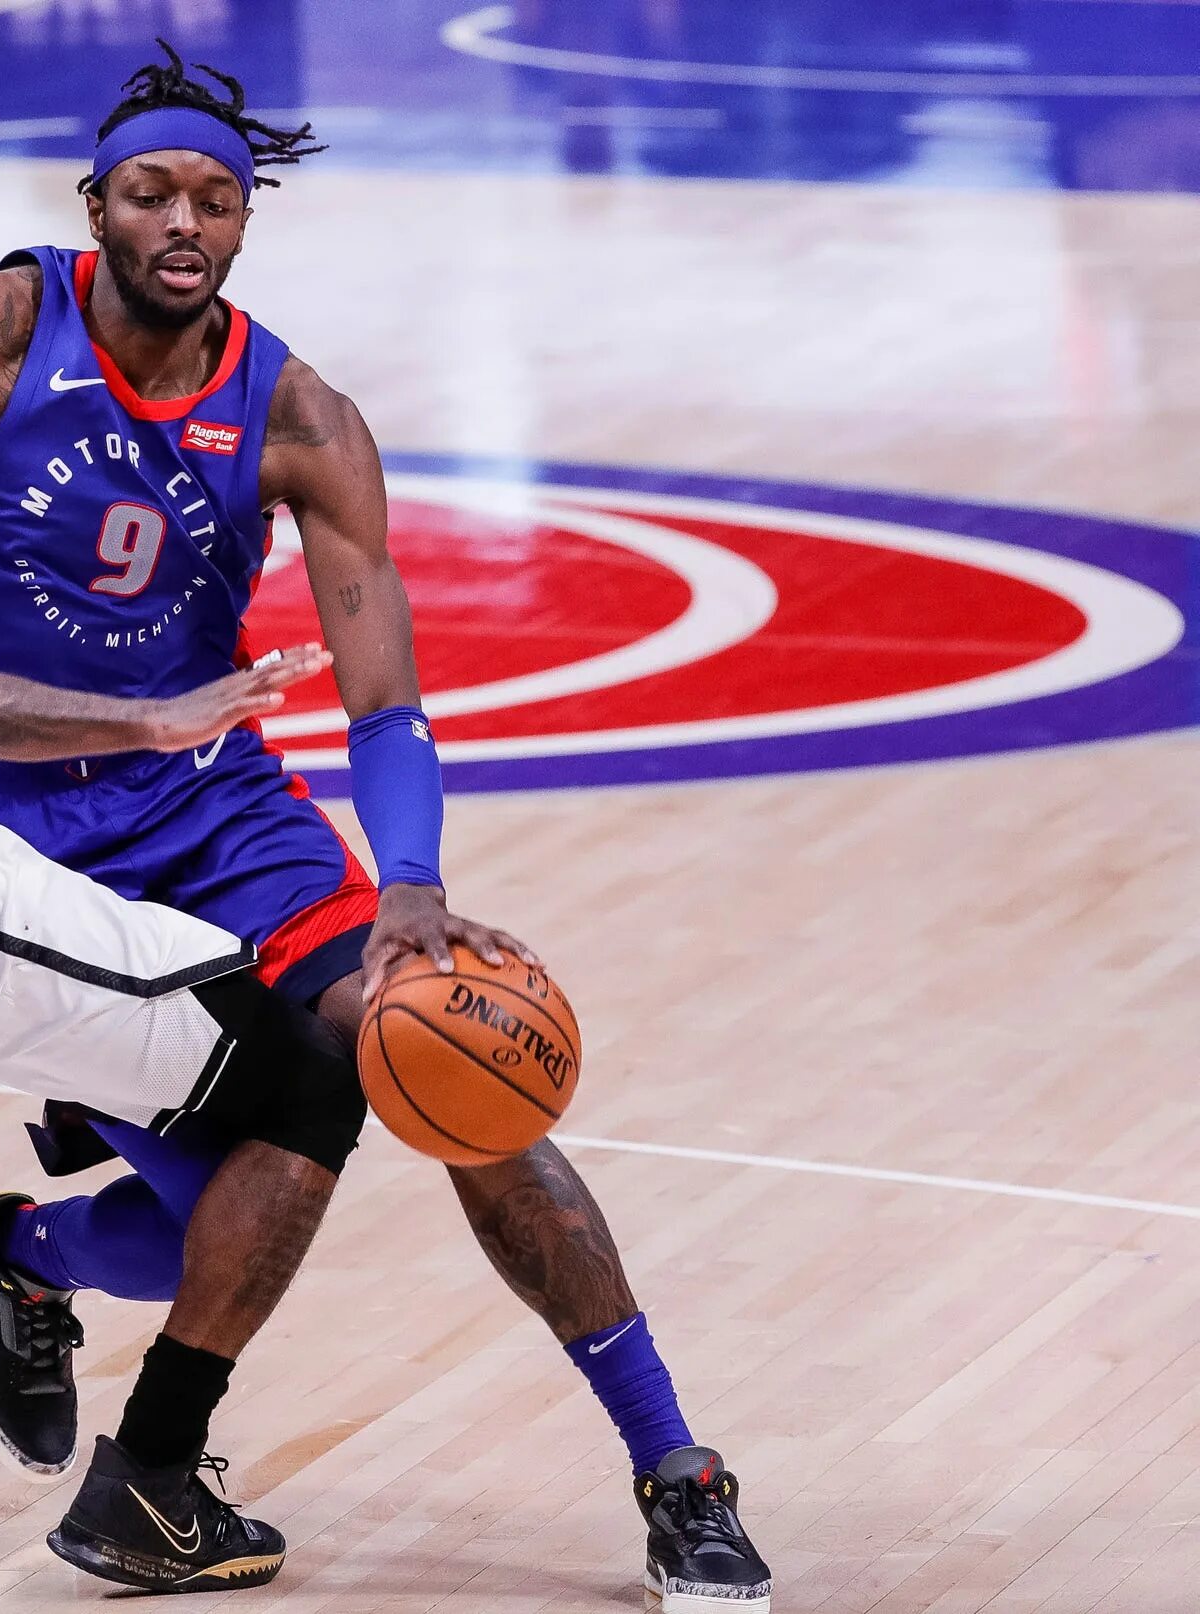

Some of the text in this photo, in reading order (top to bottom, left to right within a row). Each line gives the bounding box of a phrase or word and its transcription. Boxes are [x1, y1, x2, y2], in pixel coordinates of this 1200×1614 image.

[187, 423, 238, 442] Flagstar
[215, 442, 234, 452] Bank
[20, 433, 140, 518] MOTOR
[89, 501, 167, 597] 9
[105, 576, 207, 648] MICHIGAN
[444, 982, 572, 1092] SPALDING
